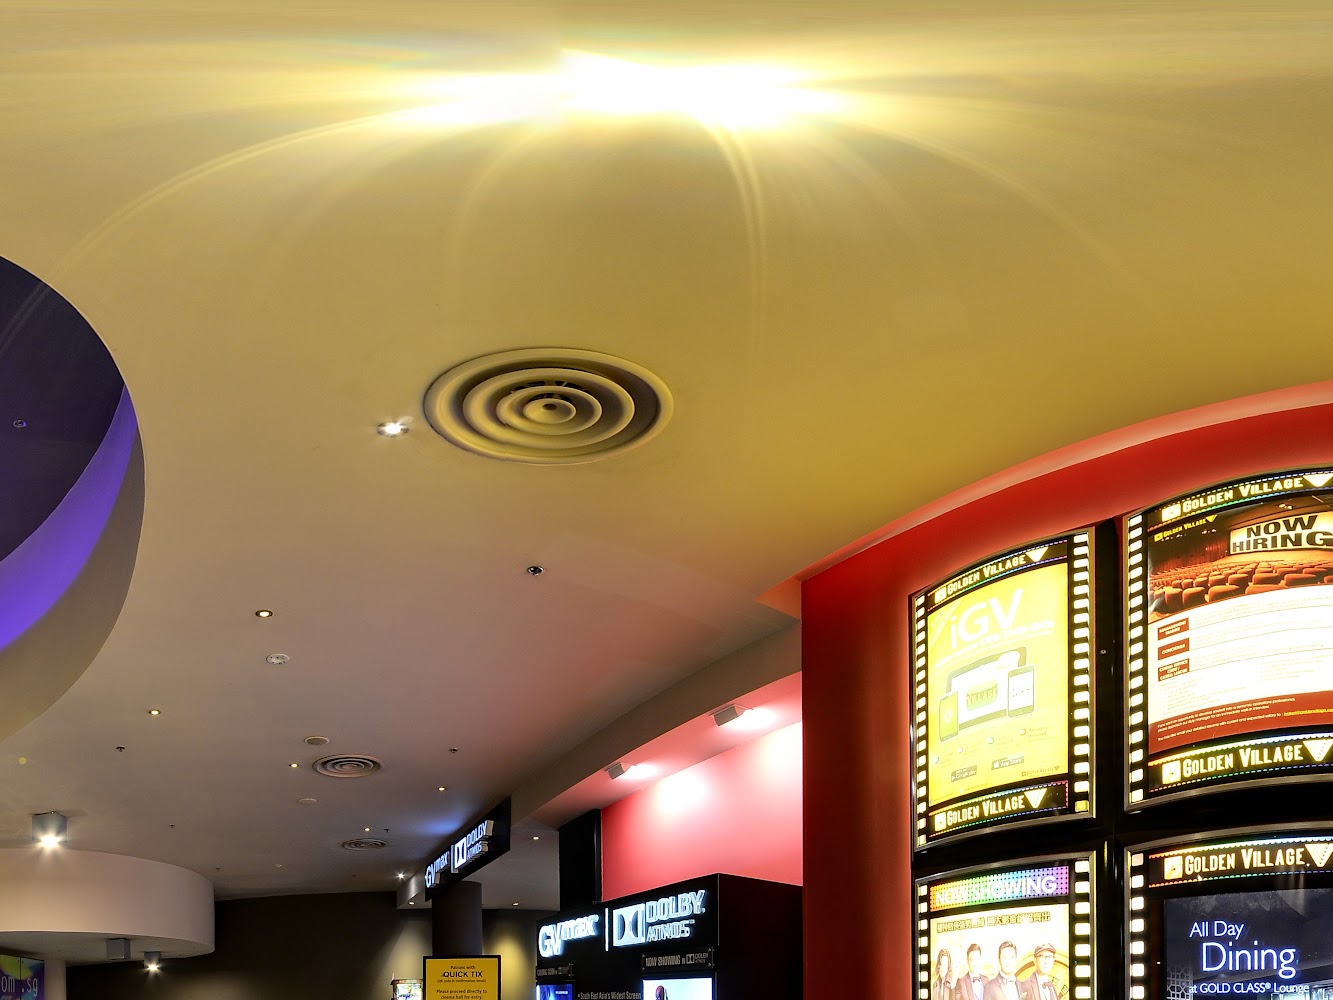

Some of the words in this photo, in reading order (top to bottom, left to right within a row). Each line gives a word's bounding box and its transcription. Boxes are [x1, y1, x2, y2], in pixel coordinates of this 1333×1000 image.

[1182, 489, 1234, 513] GOLDEN
[1239, 477, 1304, 497] VILLAGE
[1246, 515, 1318, 538] NOW
[948, 572, 980, 595] GOLDEN
[983, 555, 1026, 578] VILLAGE
[950, 588, 1024, 650] iGV
[1183, 753, 1234, 778] GOLDEN
[1239, 744, 1304, 768] VILLAGE
[947, 806, 980, 826] GOLDEN
[982, 794, 1026, 816] VILLAGE
[466, 820, 490, 848] DOLBY
[1184, 850, 1236, 876] GOLDEN
[1241, 847, 1306, 870] VILLAGE
[646, 890, 706, 923] DOLBY
[936, 887, 969, 906] NOW
[970, 876, 1057, 900] SHOWING
[1189, 920, 1211, 938] All
[1214, 920, 1244, 940] Day
[1201, 941, 1297, 979] Dining
[1188, 984, 1198, 994] at
[1200, 983, 1231, 994] GOLD
[1274, 983, 1310, 996] Lounge
